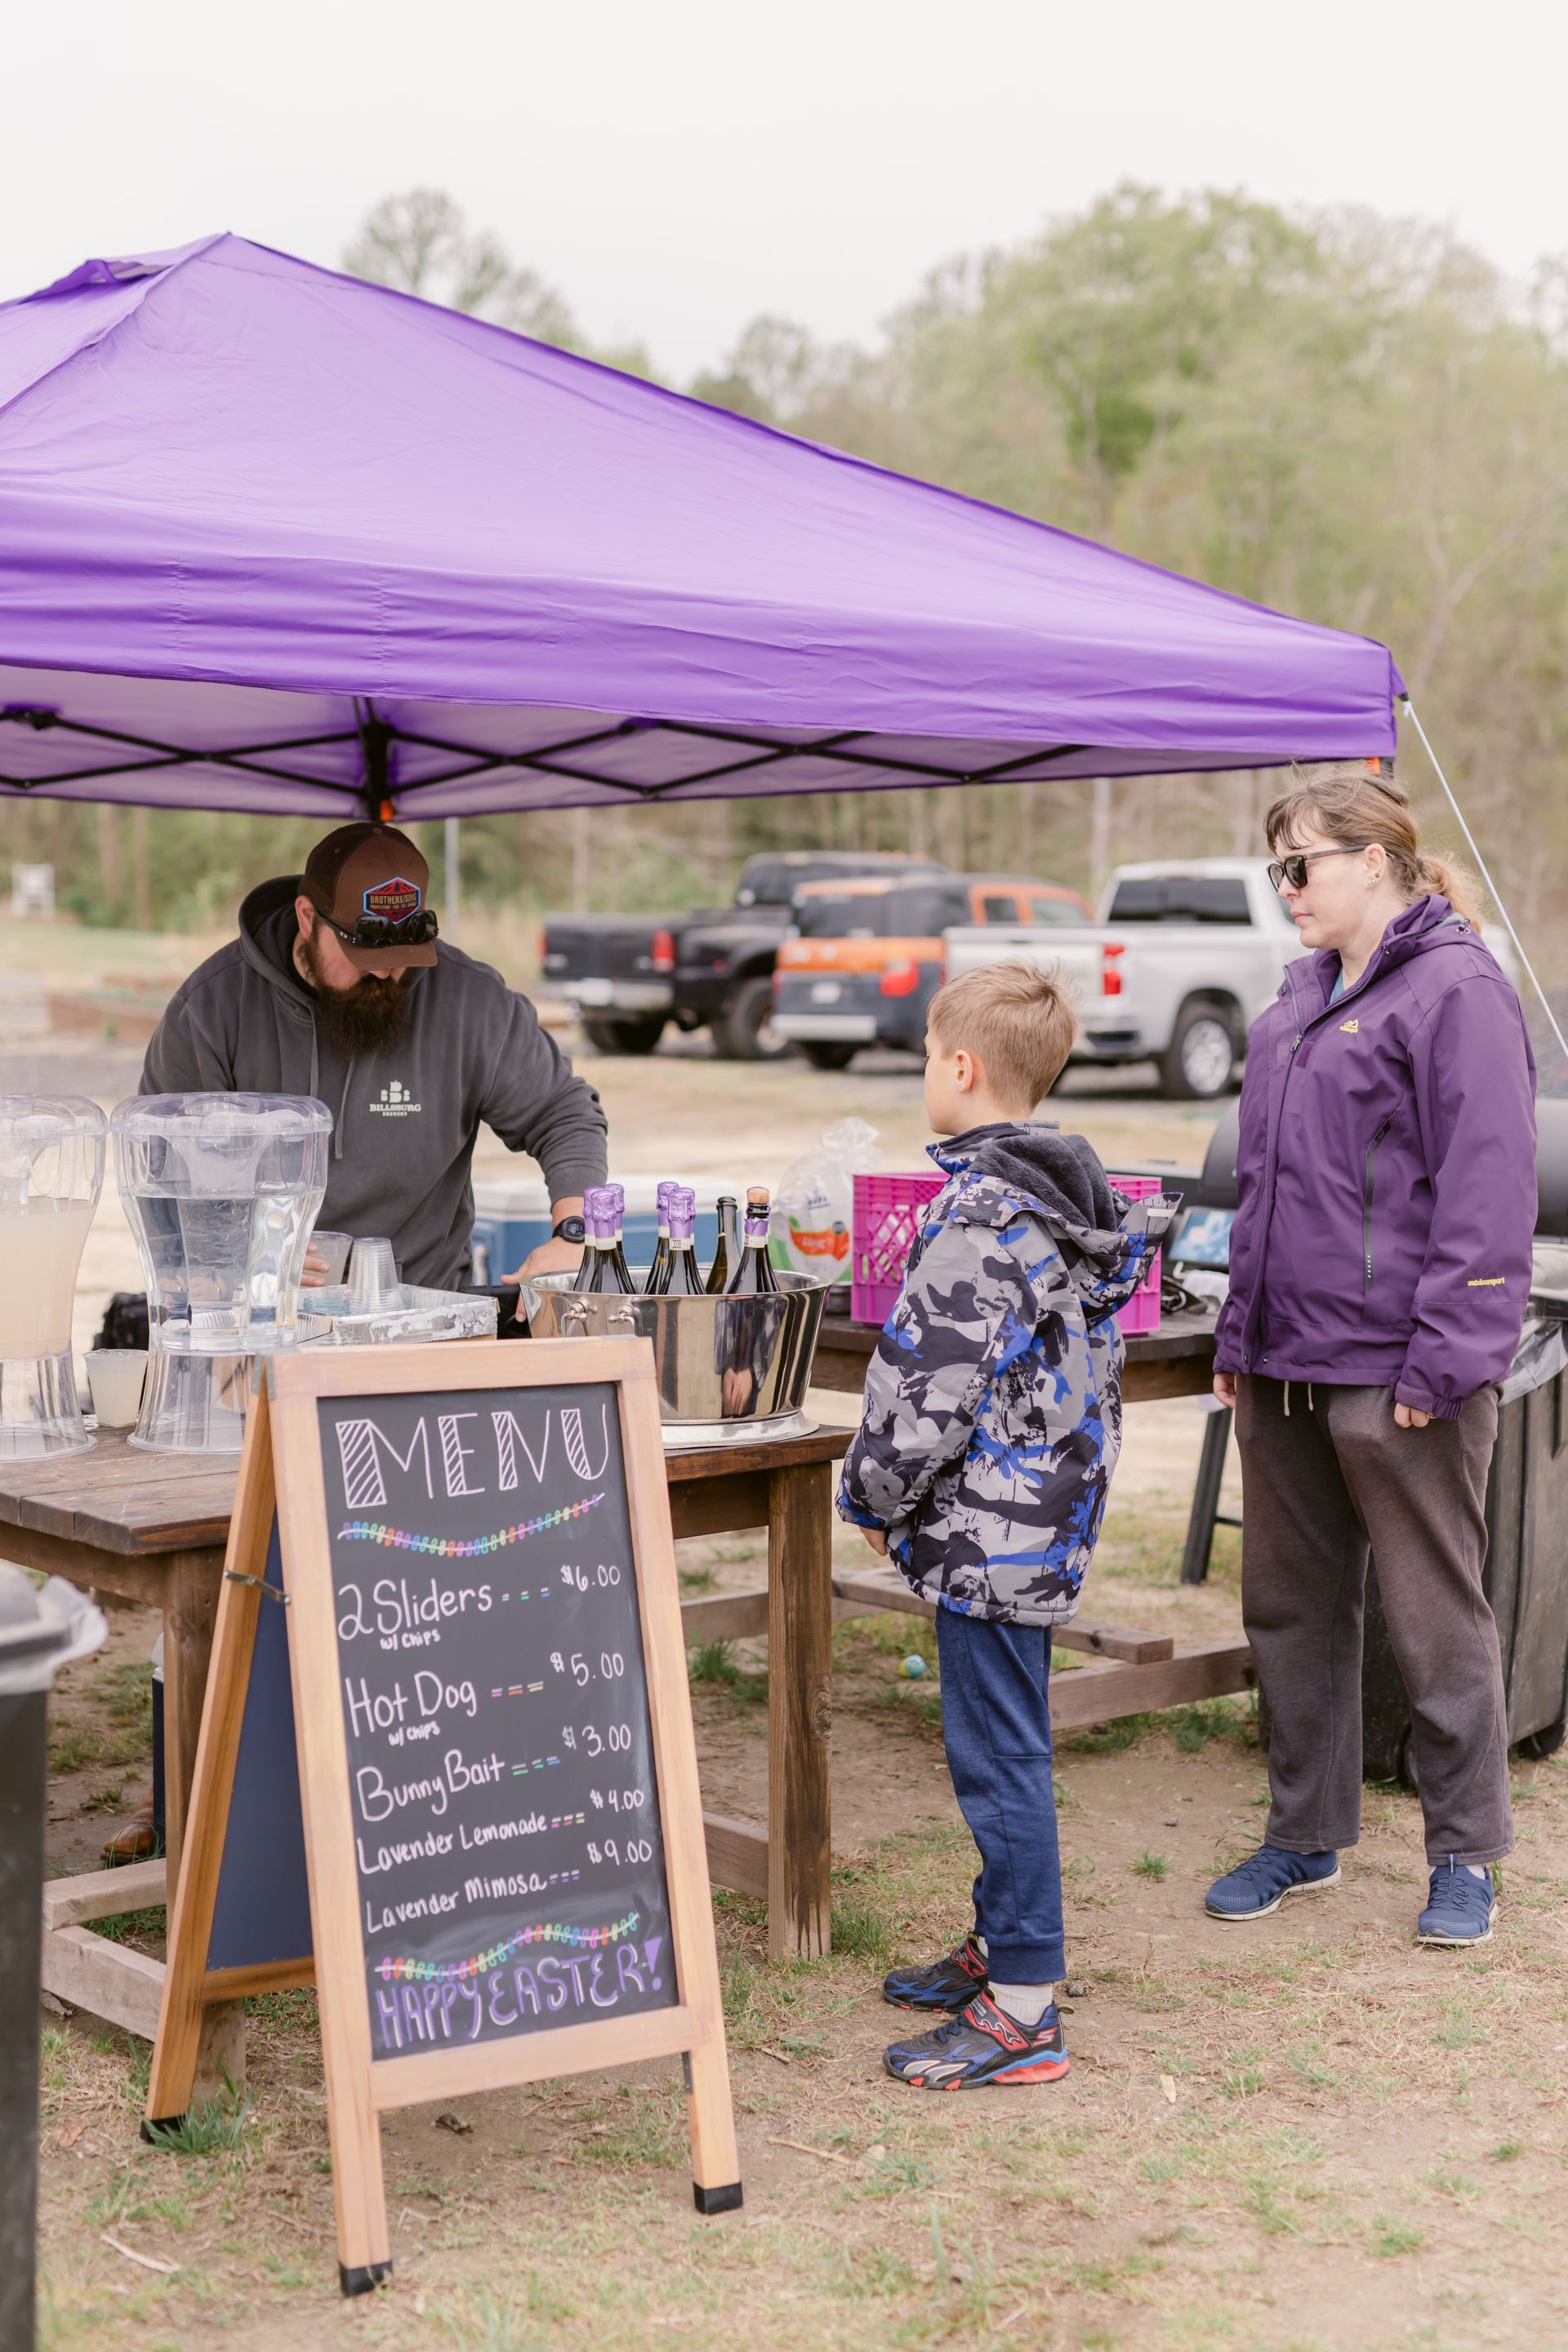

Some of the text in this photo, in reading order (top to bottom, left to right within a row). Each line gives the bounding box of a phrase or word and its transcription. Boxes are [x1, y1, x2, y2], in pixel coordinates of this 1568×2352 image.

[369, 1103, 421, 1111] BILLSBURG
[1468, 1276, 1505, 1286] outdoorsport
[336, 1404, 609, 1509] MENU
[337, 1565, 621, 1641] 2 Sliders $6.00
[380, 1633, 398, 1650] w/
[345, 1651, 624, 1737] Hot Dog $5.00
[388, 1726, 404, 1746] w/
[356, 1724, 631, 1821] Bunny Bait $3.00
[357, 1788, 644, 1874] Lavender Lemonade $4.00
[367, 1891, 459, 1934] Lavender
[587, 1838, 653, 1866] $9.00
[376, 1936, 662, 2048] HAPPY EASTER!
